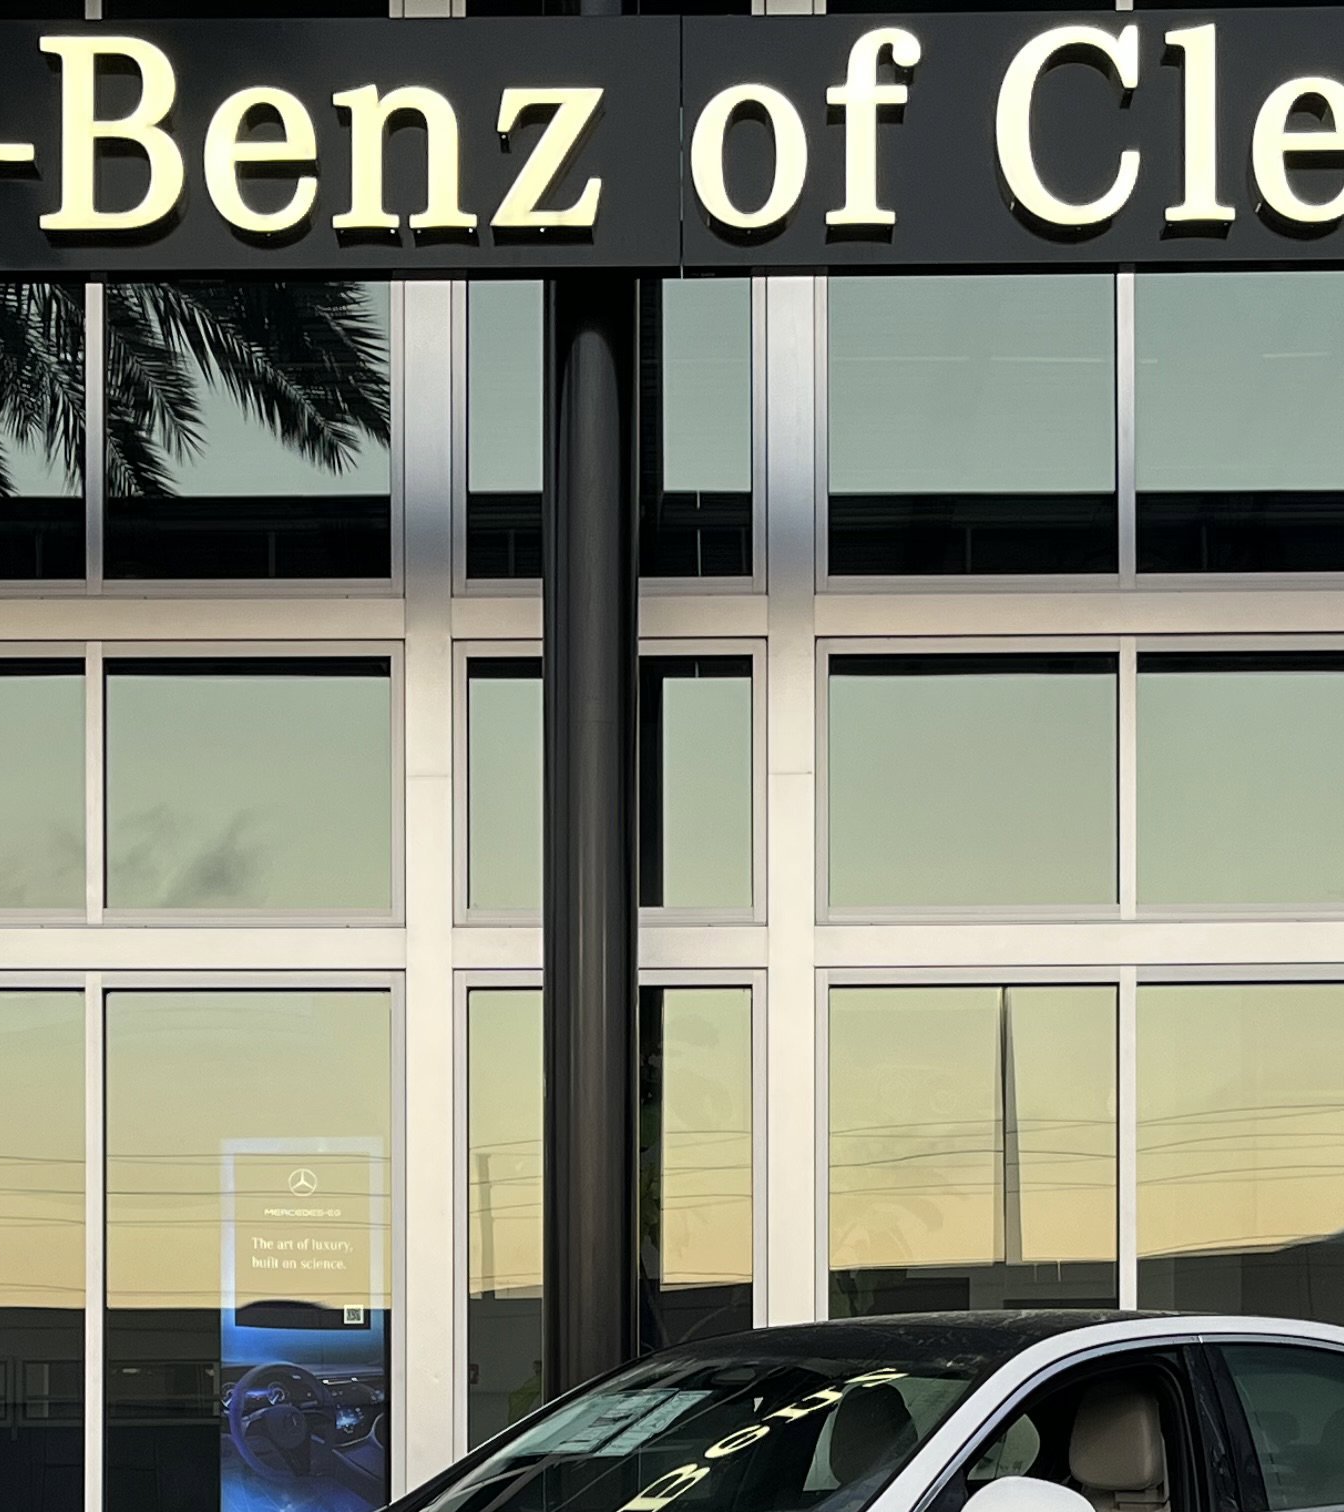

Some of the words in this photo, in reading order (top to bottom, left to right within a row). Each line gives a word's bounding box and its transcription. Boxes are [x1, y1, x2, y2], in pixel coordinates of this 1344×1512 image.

[690, 27, 921, 228] of
[251, 1237, 274, 1250] The
[277, 1238, 294, 1250] art
[297, 1238, 309, 1250] of
[311, 1238, 354, 1253] luxury,
[251, 1256, 279, 1269] built
[282, 1258, 297, 1270] on
[300, 1257, 347, 1270] science.
